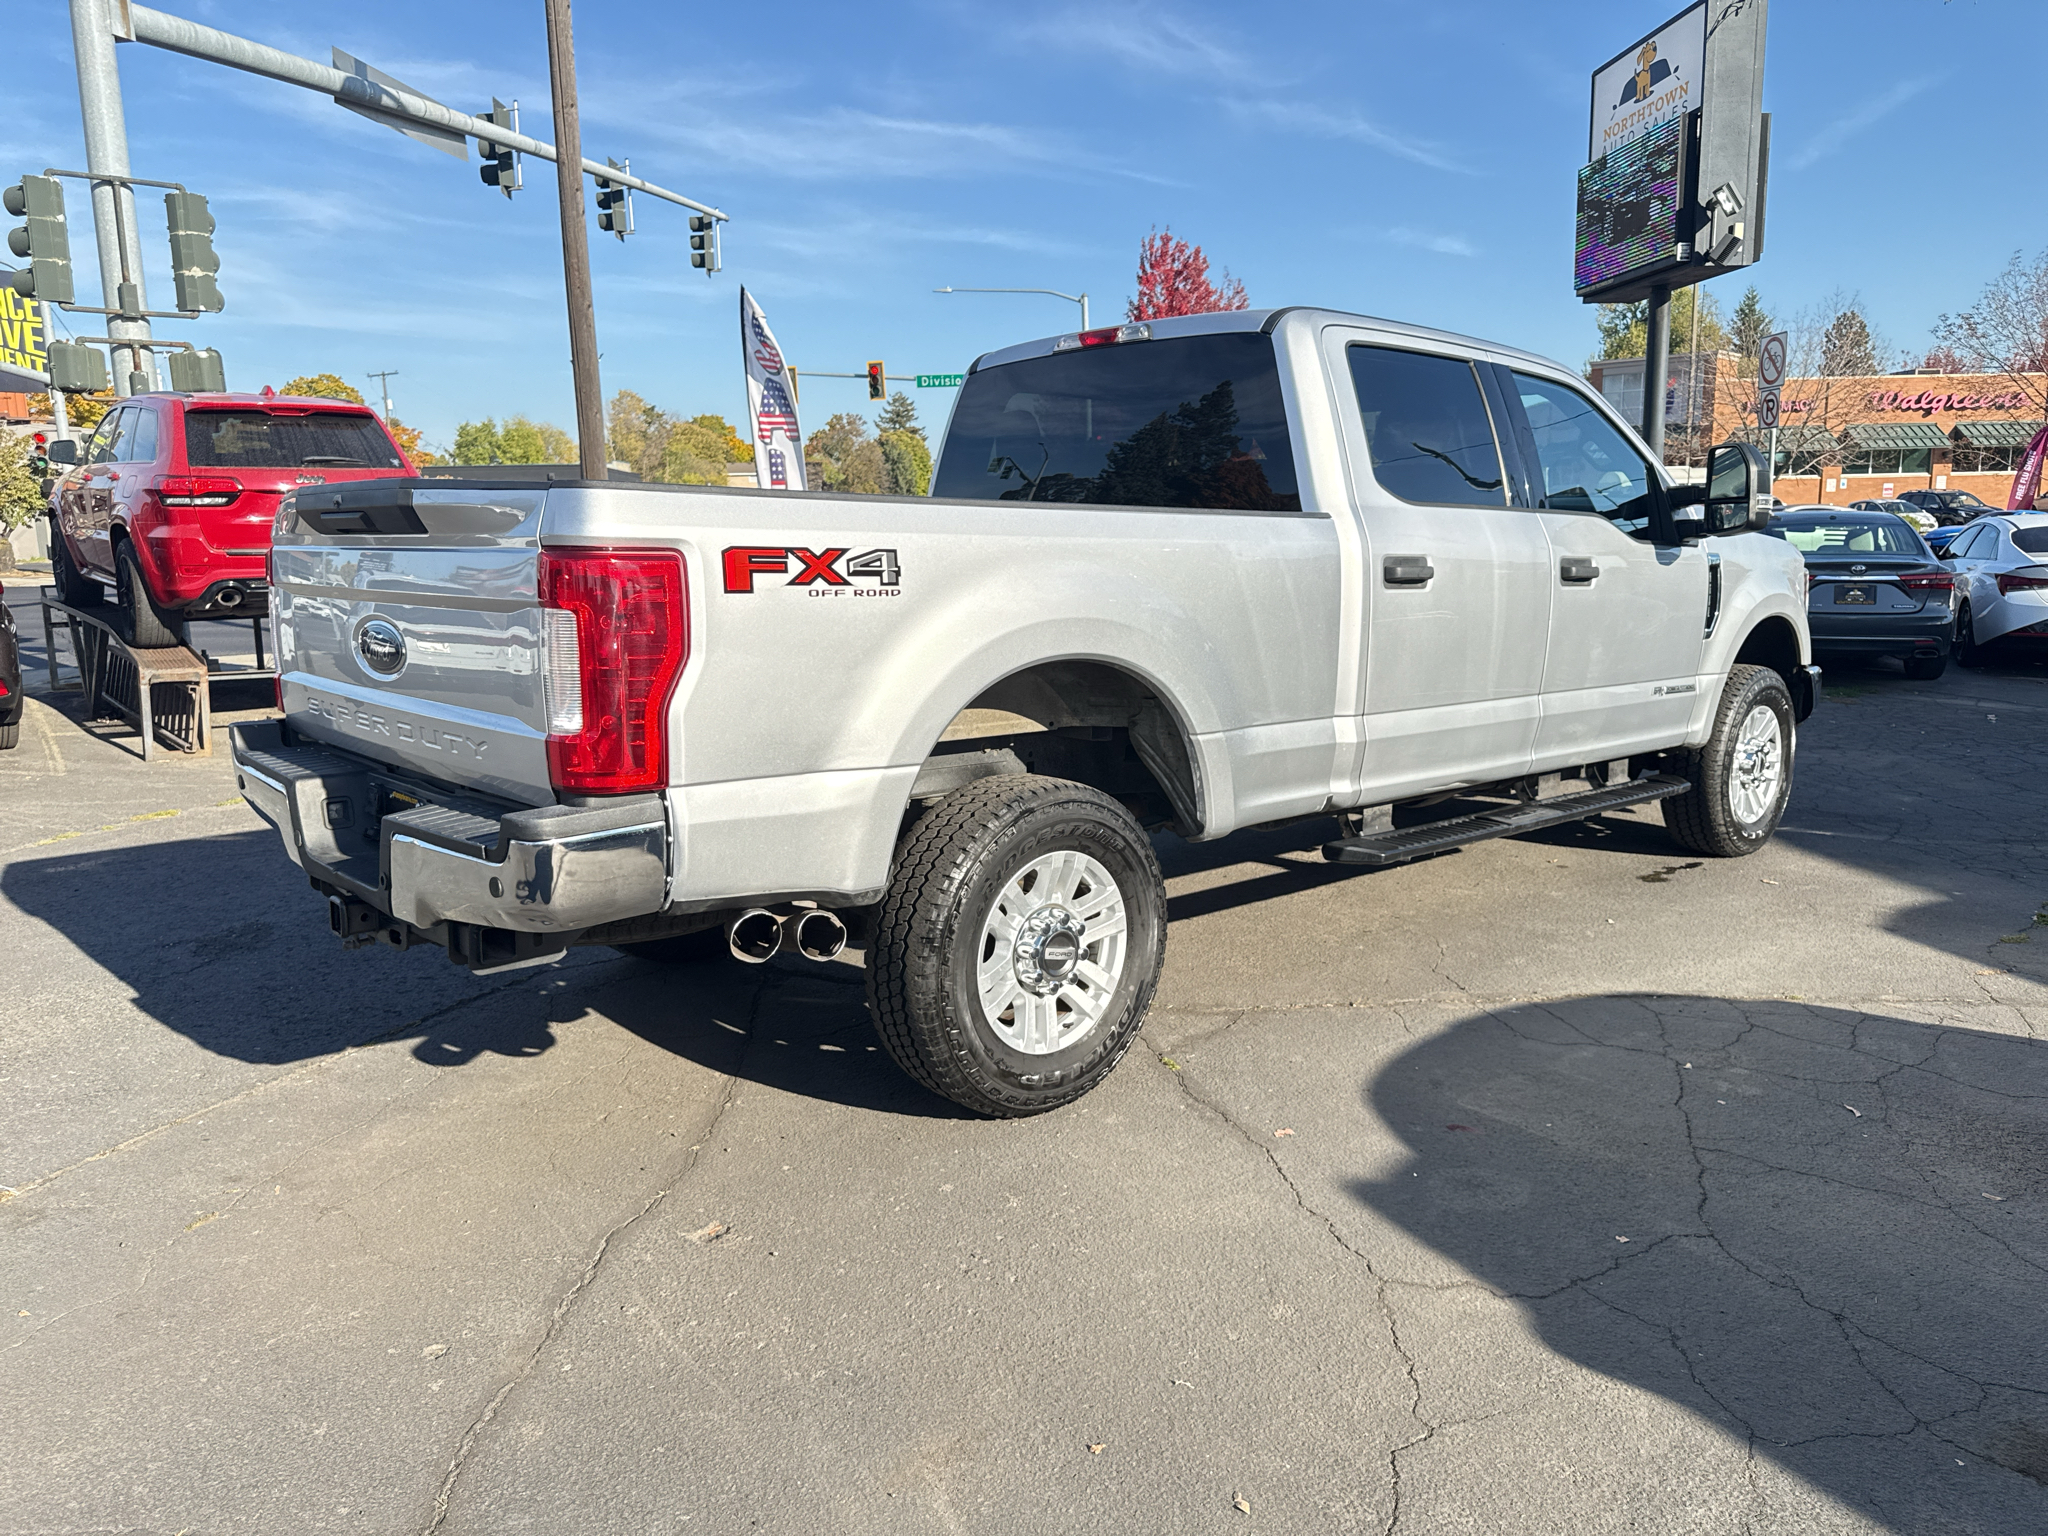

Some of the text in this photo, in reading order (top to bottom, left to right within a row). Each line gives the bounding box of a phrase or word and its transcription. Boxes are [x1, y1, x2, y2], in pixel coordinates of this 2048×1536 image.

[1603, 80, 1689, 142] NORTHTOWN
[0, 320, 47, 357] VE
[921, 375, 962, 387] Divisio
[1871, 389, 2031, 414] Walgreens
[296, 473, 326, 485] Jeep
[2020, 471, 2029, 484] FLU
[2015, 484, 2026, 500] FREE
[721, 546, 901, 594] FX4
[808, 589, 901, 597] OFF ROAD
[364, 631, 392, 662] Ford
[308, 697, 487, 759] SUPER DUTY
